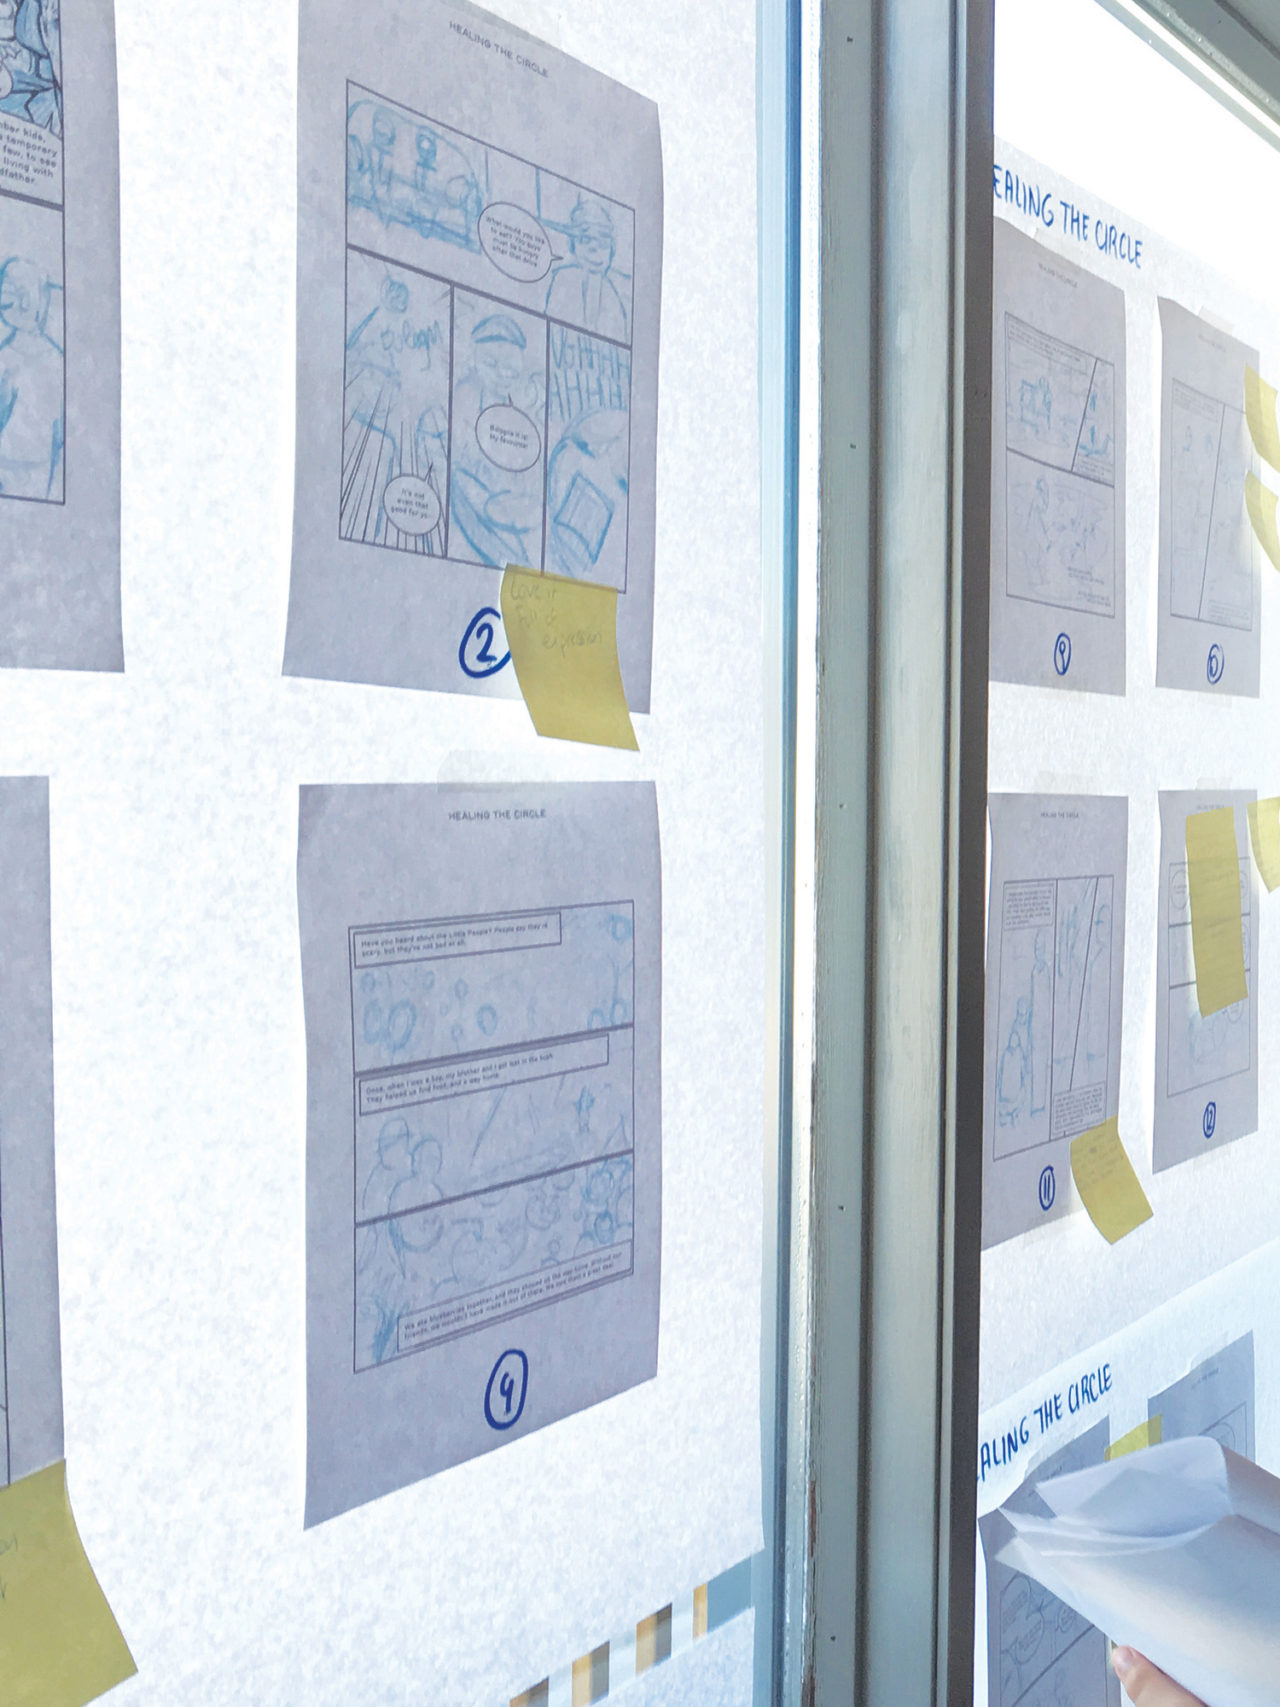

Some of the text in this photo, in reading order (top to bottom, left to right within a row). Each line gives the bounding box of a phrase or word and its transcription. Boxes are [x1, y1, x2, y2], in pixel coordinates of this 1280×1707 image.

[449, 20, 549, 78] HEALING THE CIRCLE
[6, 135, 57, 157] temporary
[3, 157, 54, 179] living with
[1060, 200, 1090, 241] THE
[1095, 219, 1143, 270] CIRCLE
[476, 622, 497, 662] 2
[449, 808, 547, 821] HEALING THE CIRCLE
[977, 1363, 1113, 1482] ALING THE CIRCLE
